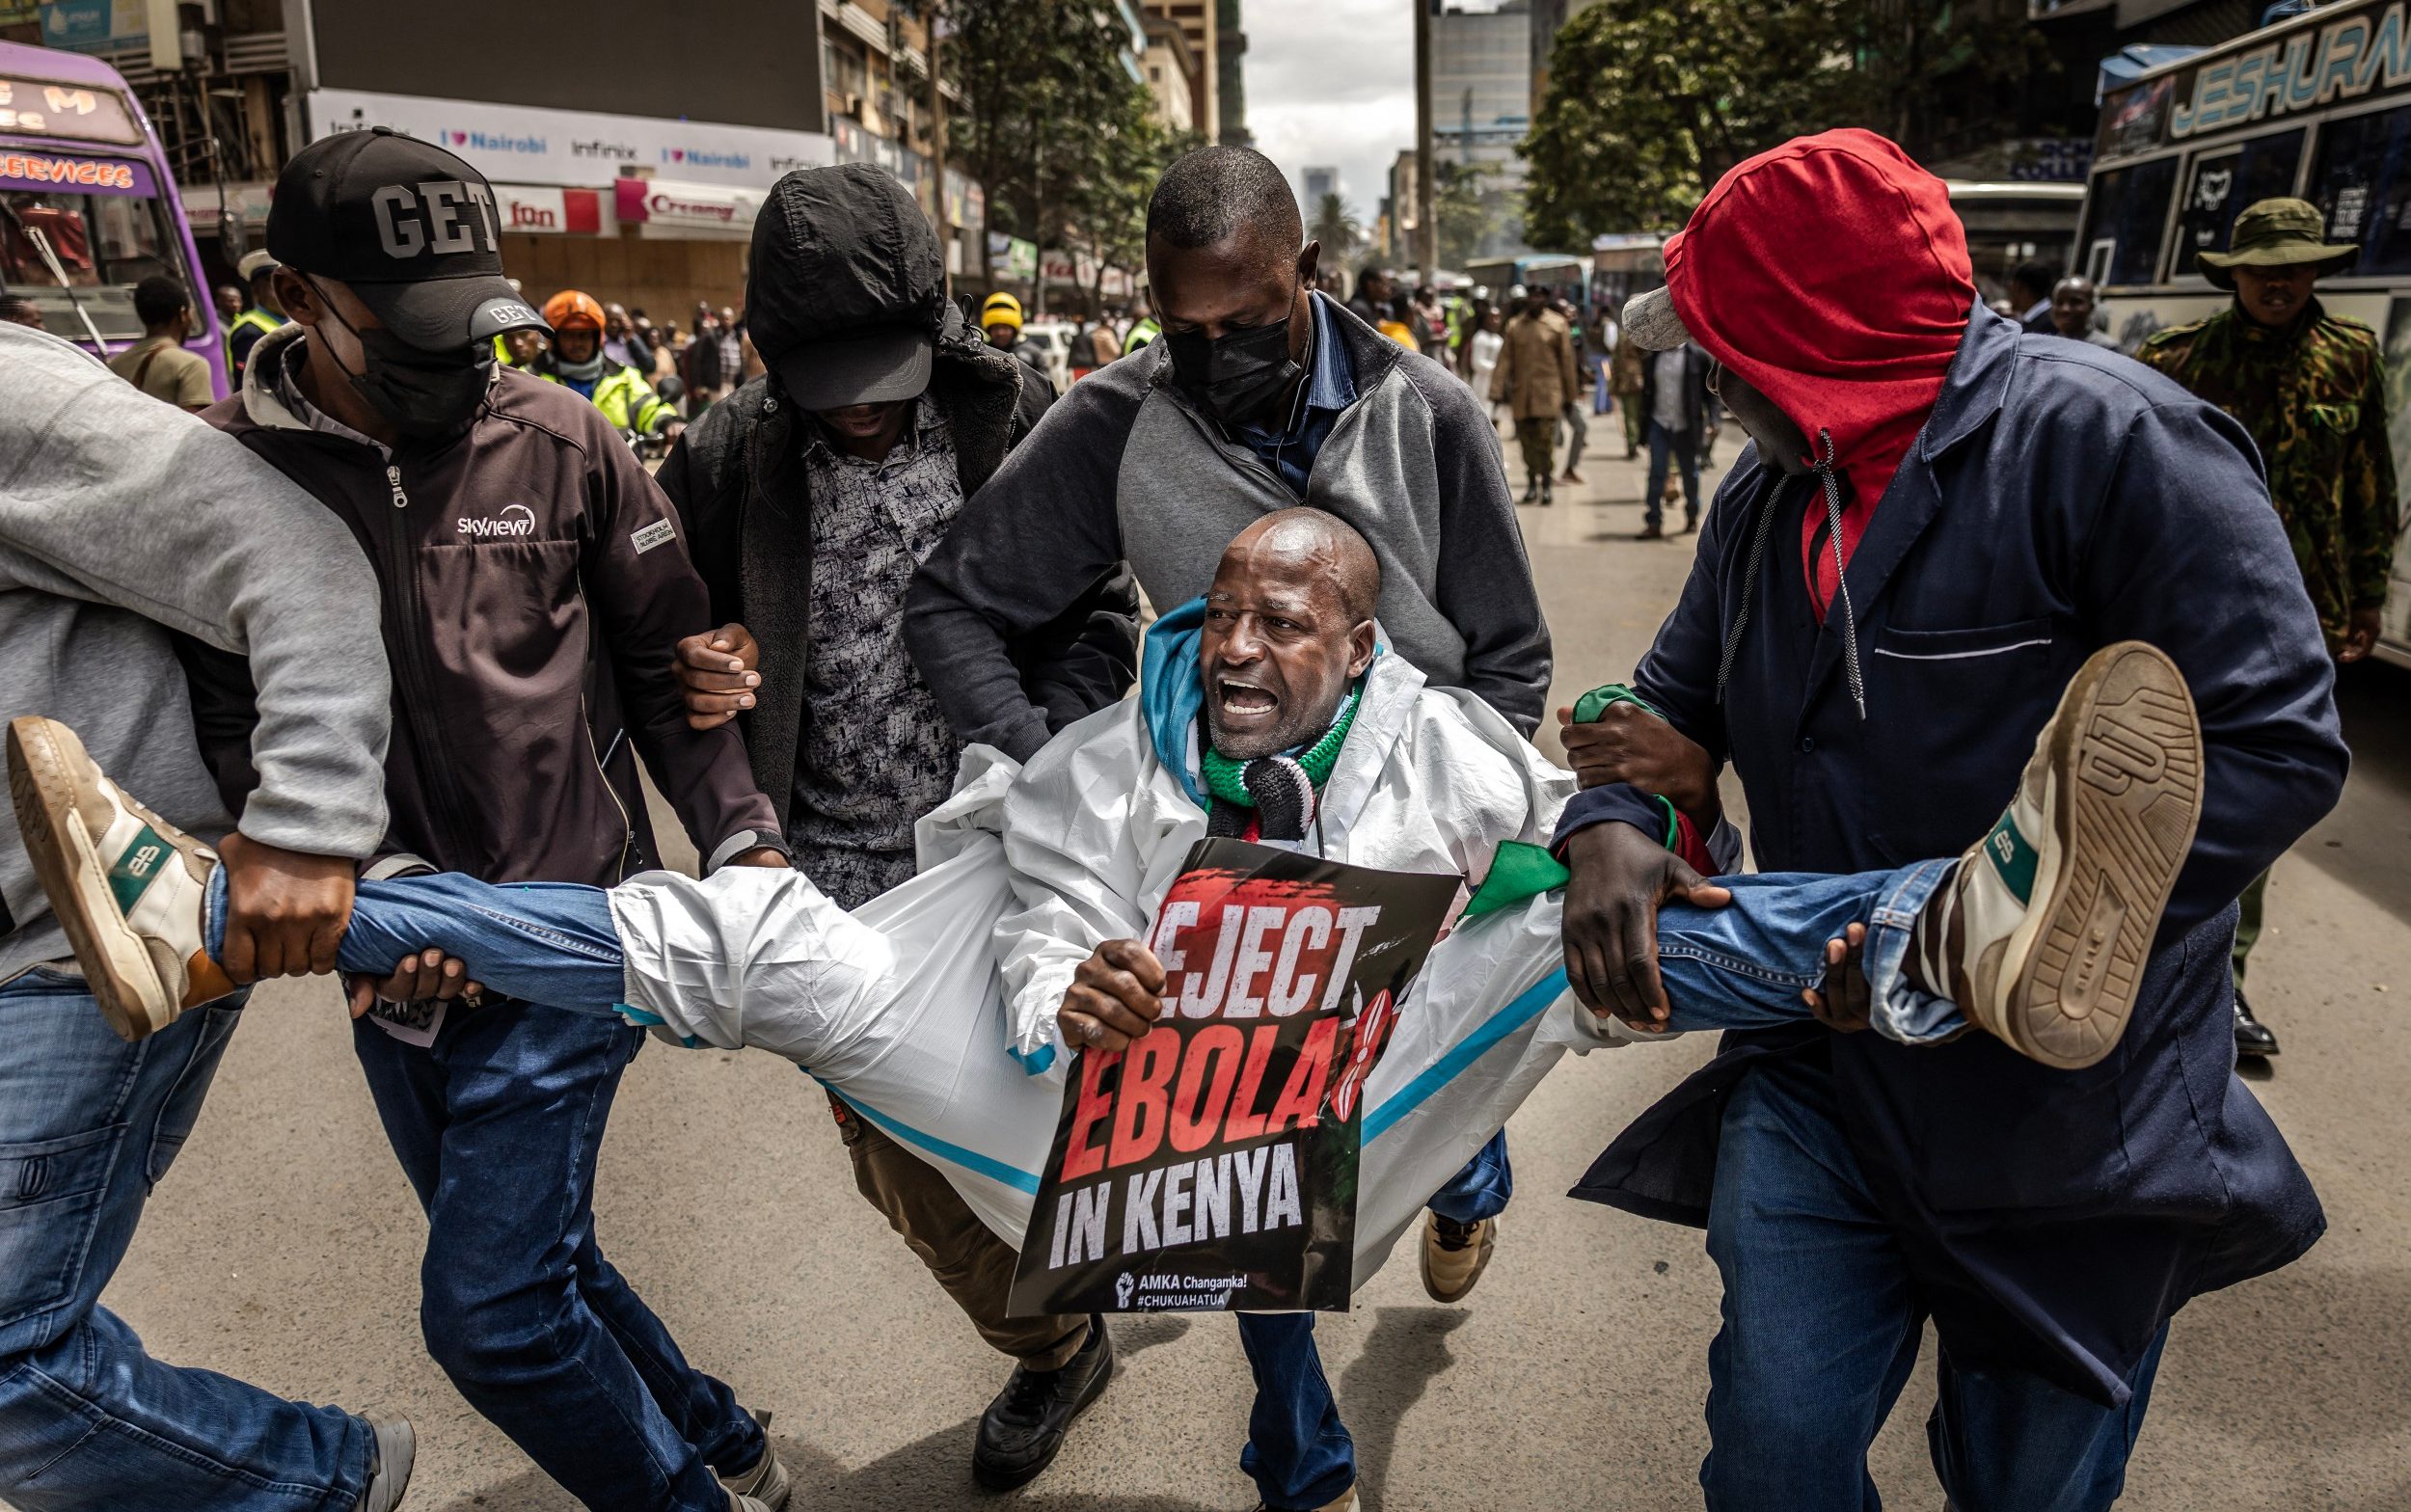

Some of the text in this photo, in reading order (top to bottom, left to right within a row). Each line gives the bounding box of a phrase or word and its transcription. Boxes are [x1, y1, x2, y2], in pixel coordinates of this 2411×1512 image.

[2171, 2, 2411, 139] JESHURA
[440, 128, 548, 154] I Nairobi
[572, 140, 639, 161] Infinix
[686, 147, 751, 170] Nairobi
[769, 155, 826, 171] Infin
[371, 181, 498, 259] GET
[650, 194, 736, 223] Creamy
[489, 305, 537, 324] GET
[1148, 901, 1382, 1019] EJECT
[1060, 1016, 1341, 1184] EBOLA
[1048, 1142, 1303, 1270] IN KENYA
[1138, 1273, 1248, 1292] AMKA Changamka!
[1137, 1293, 1226, 1308] #CHUKUAHATUA
